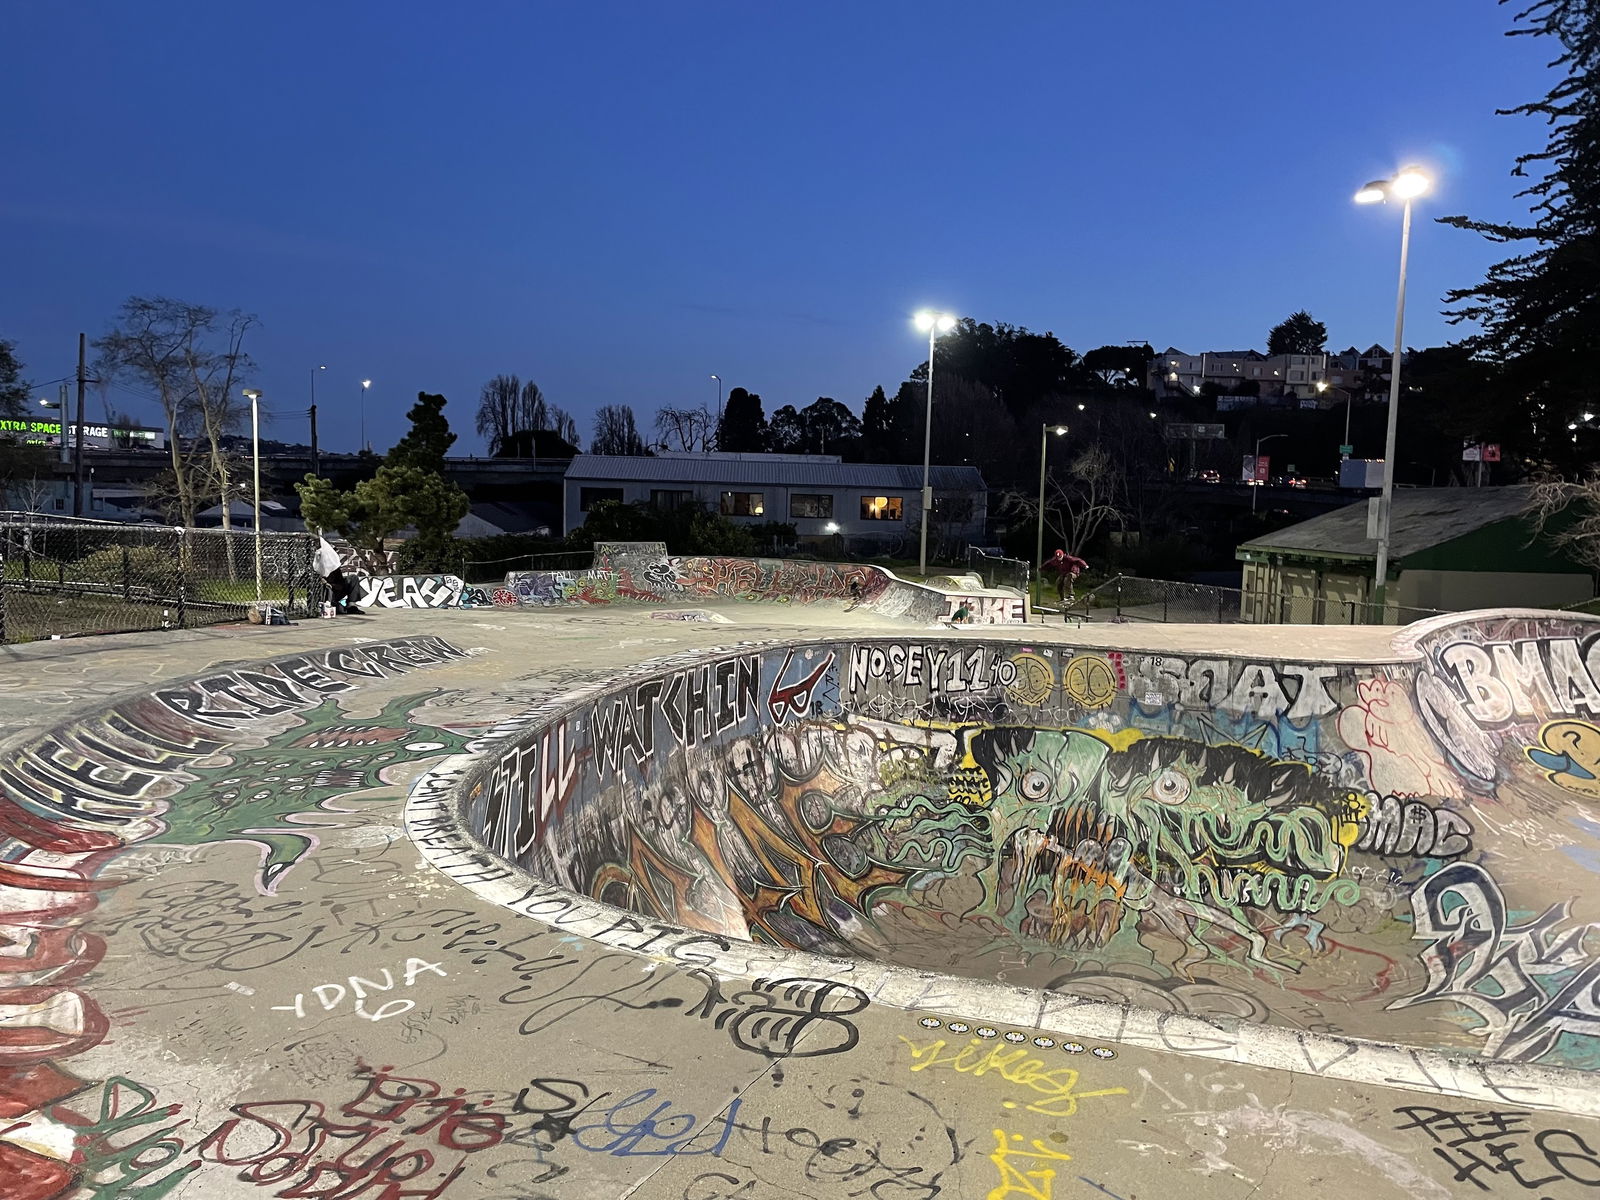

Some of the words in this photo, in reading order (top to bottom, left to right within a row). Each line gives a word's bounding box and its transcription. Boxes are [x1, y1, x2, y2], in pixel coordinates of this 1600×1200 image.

[30, 422, 61, 434] SPACE
[68, 425, 108, 437] STRAGE
[549, 571, 574, 581] TALL
[1437, 637, 1600, 733] BMA
[482, 720, 577, 861] STILL
[591, 654, 762, 783] WATCHIN
